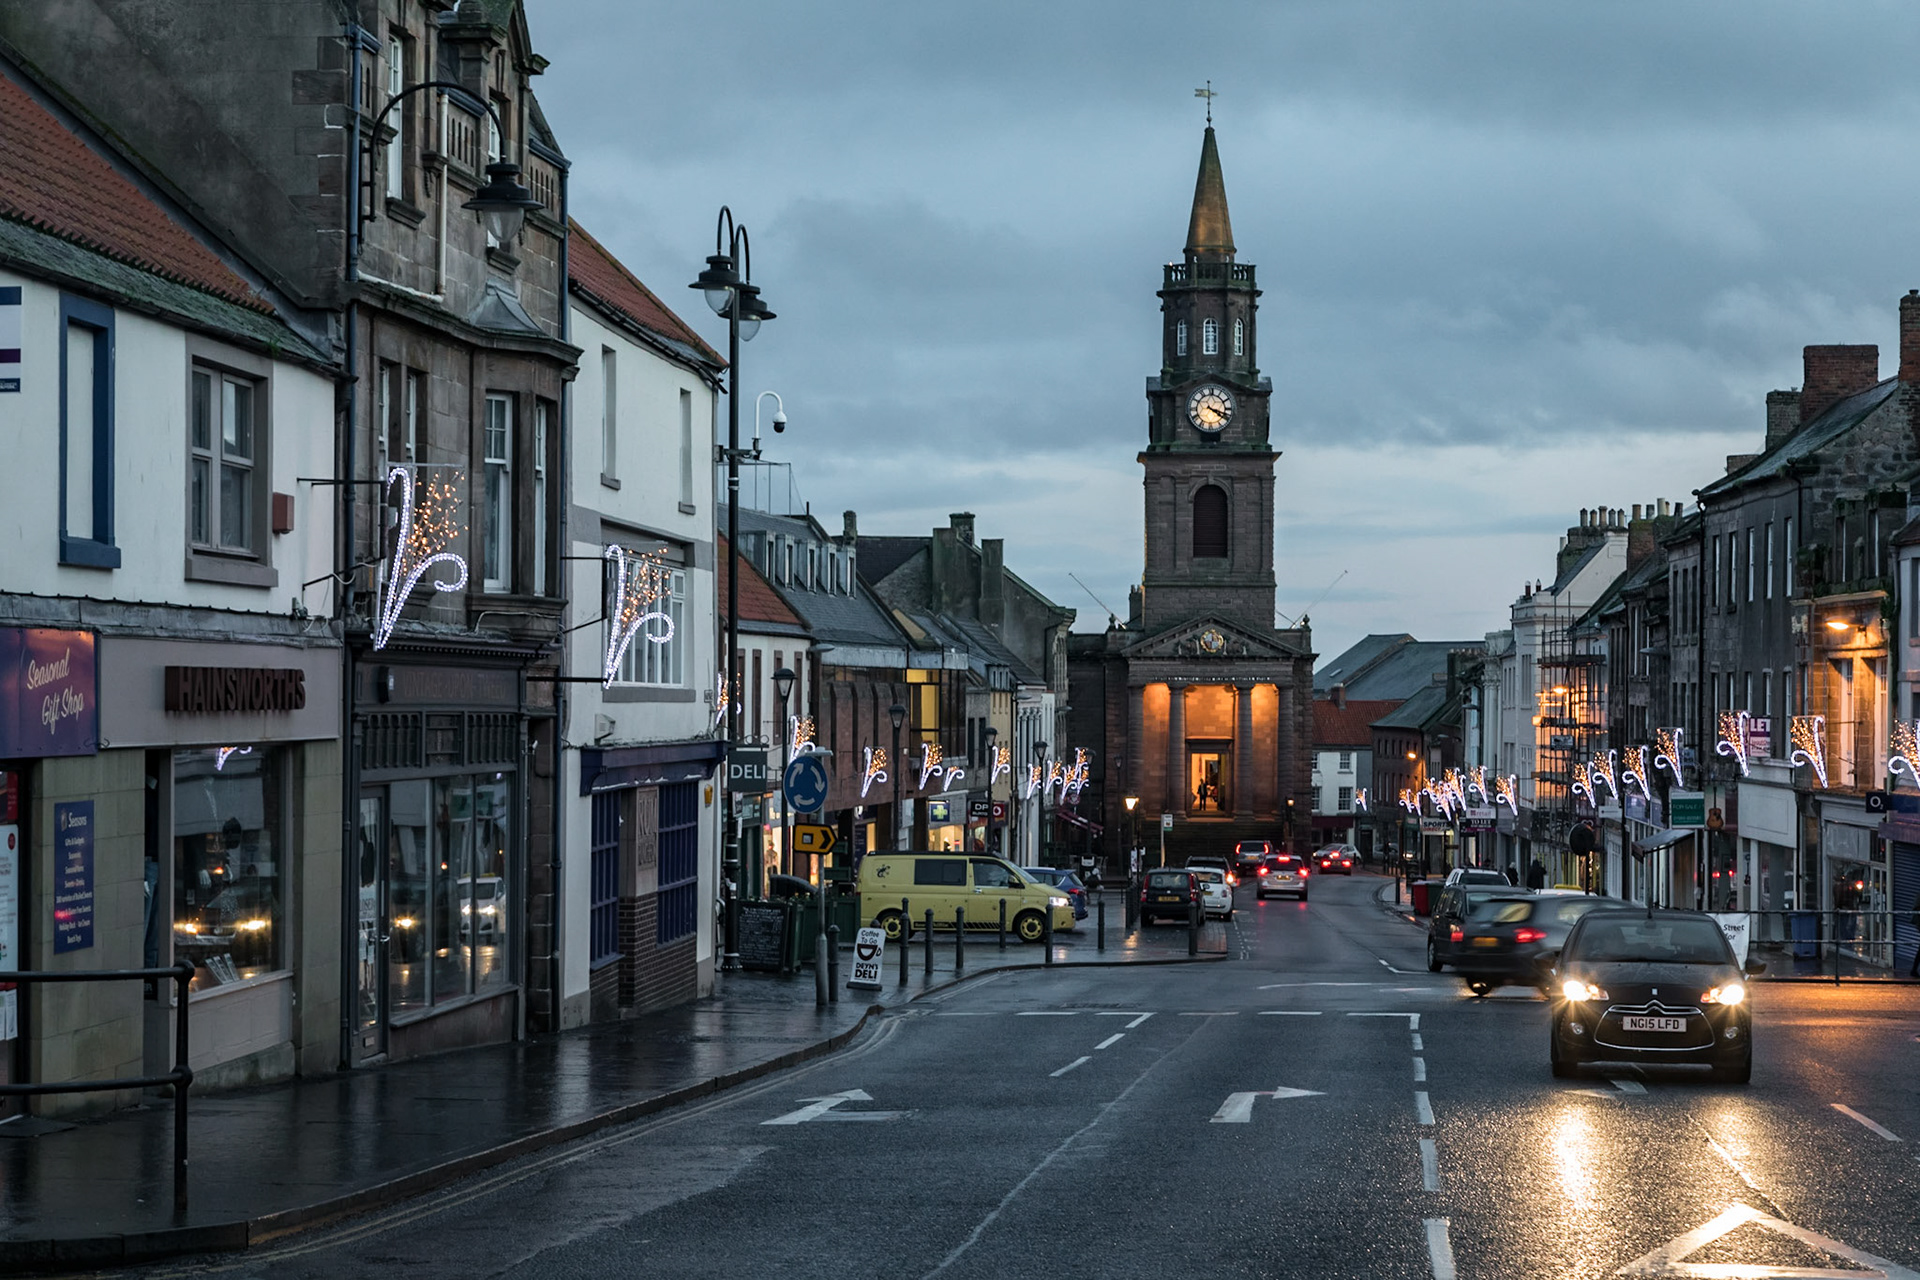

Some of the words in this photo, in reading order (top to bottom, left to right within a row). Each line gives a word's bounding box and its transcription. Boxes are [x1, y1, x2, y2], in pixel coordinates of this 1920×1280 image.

[27, 647, 70, 690] Seasonal
[178, 667, 306, 709] HAINSWORTHS
[41, 692, 60, 735] Gift
[60, 685, 84, 722] Shop
[1750, 718, 1771, 732] LET
[730, 764, 766, 779] DELI
[974, 803, 989, 811] DP
[861, 930, 880, 938] Coffee
[854, 969, 878, 979] DELI
[1630, 1018, 1655, 1029] NG15
[1657, 1019, 1680, 1030] LFD
